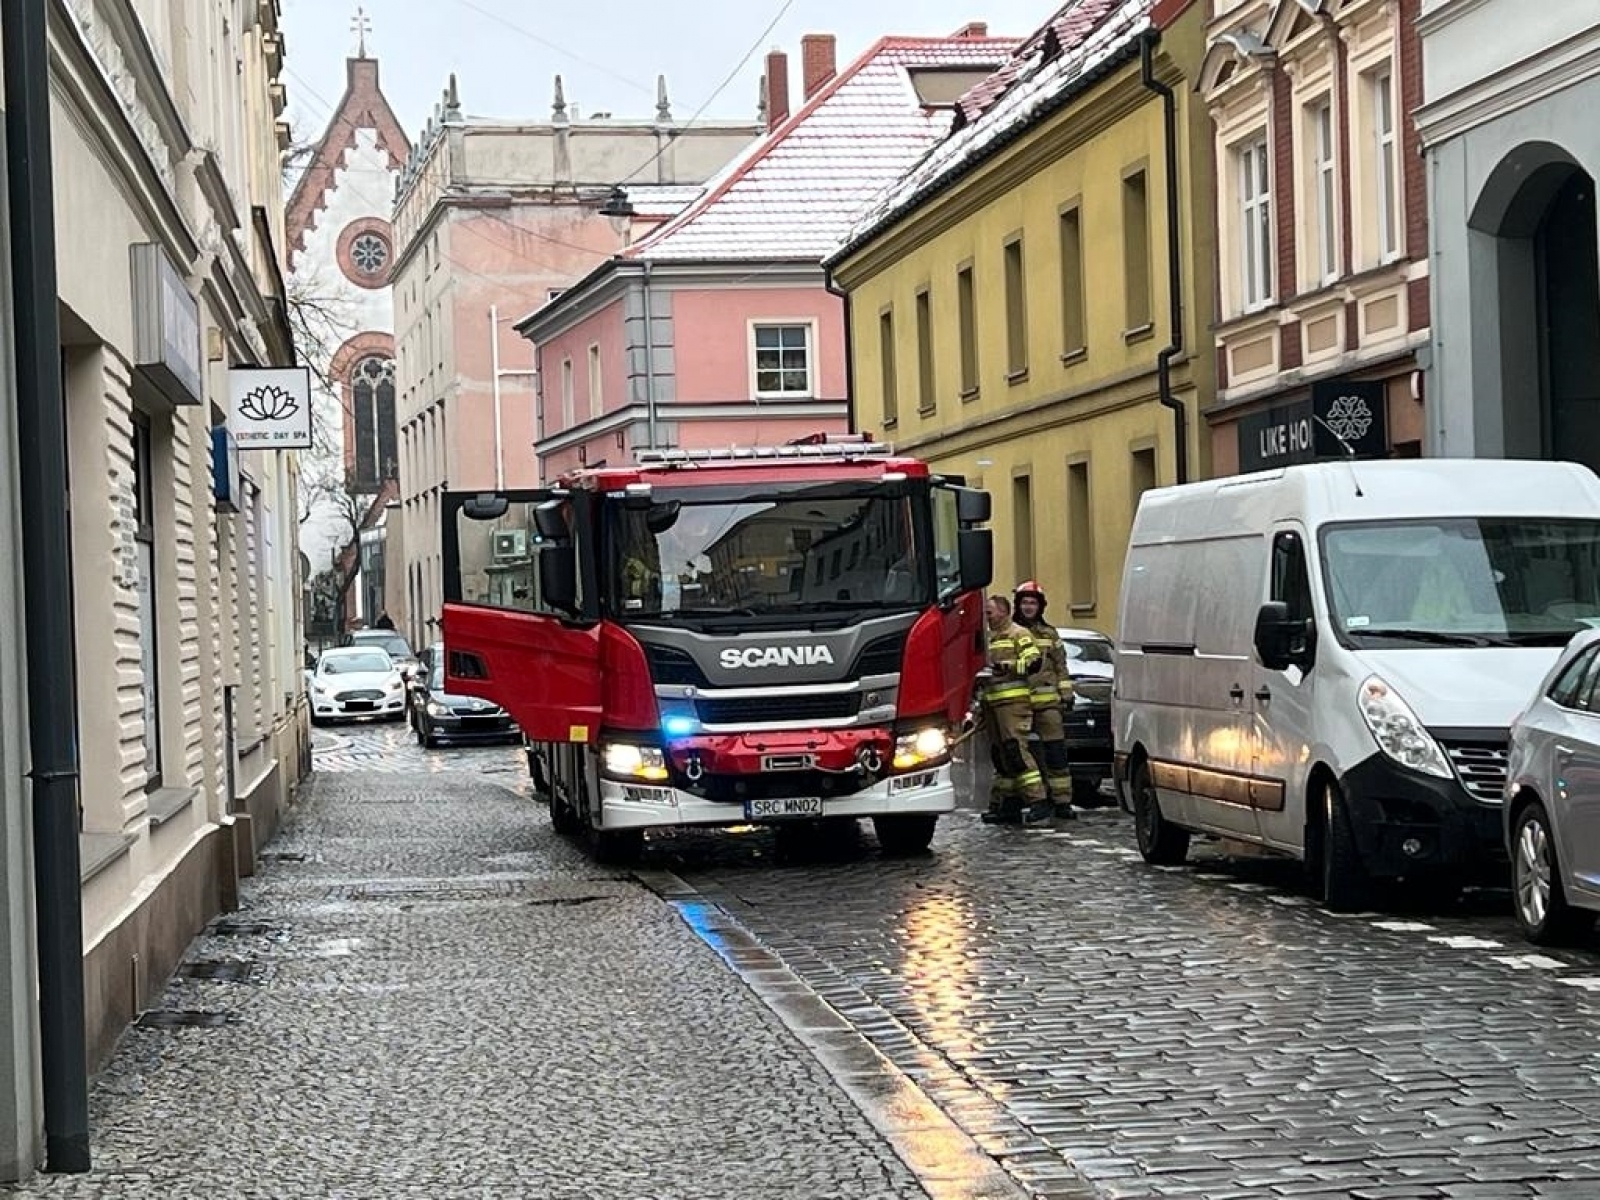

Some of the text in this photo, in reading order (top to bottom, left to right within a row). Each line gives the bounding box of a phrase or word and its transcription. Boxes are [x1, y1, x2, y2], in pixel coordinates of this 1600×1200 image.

[273, 430, 289, 440] DAY
[293, 430, 307, 440] SPA
[1260, 424, 1287, 458] LIKE
[719, 644, 834, 669] SCANIA
[754, 799, 780, 815] SRC
